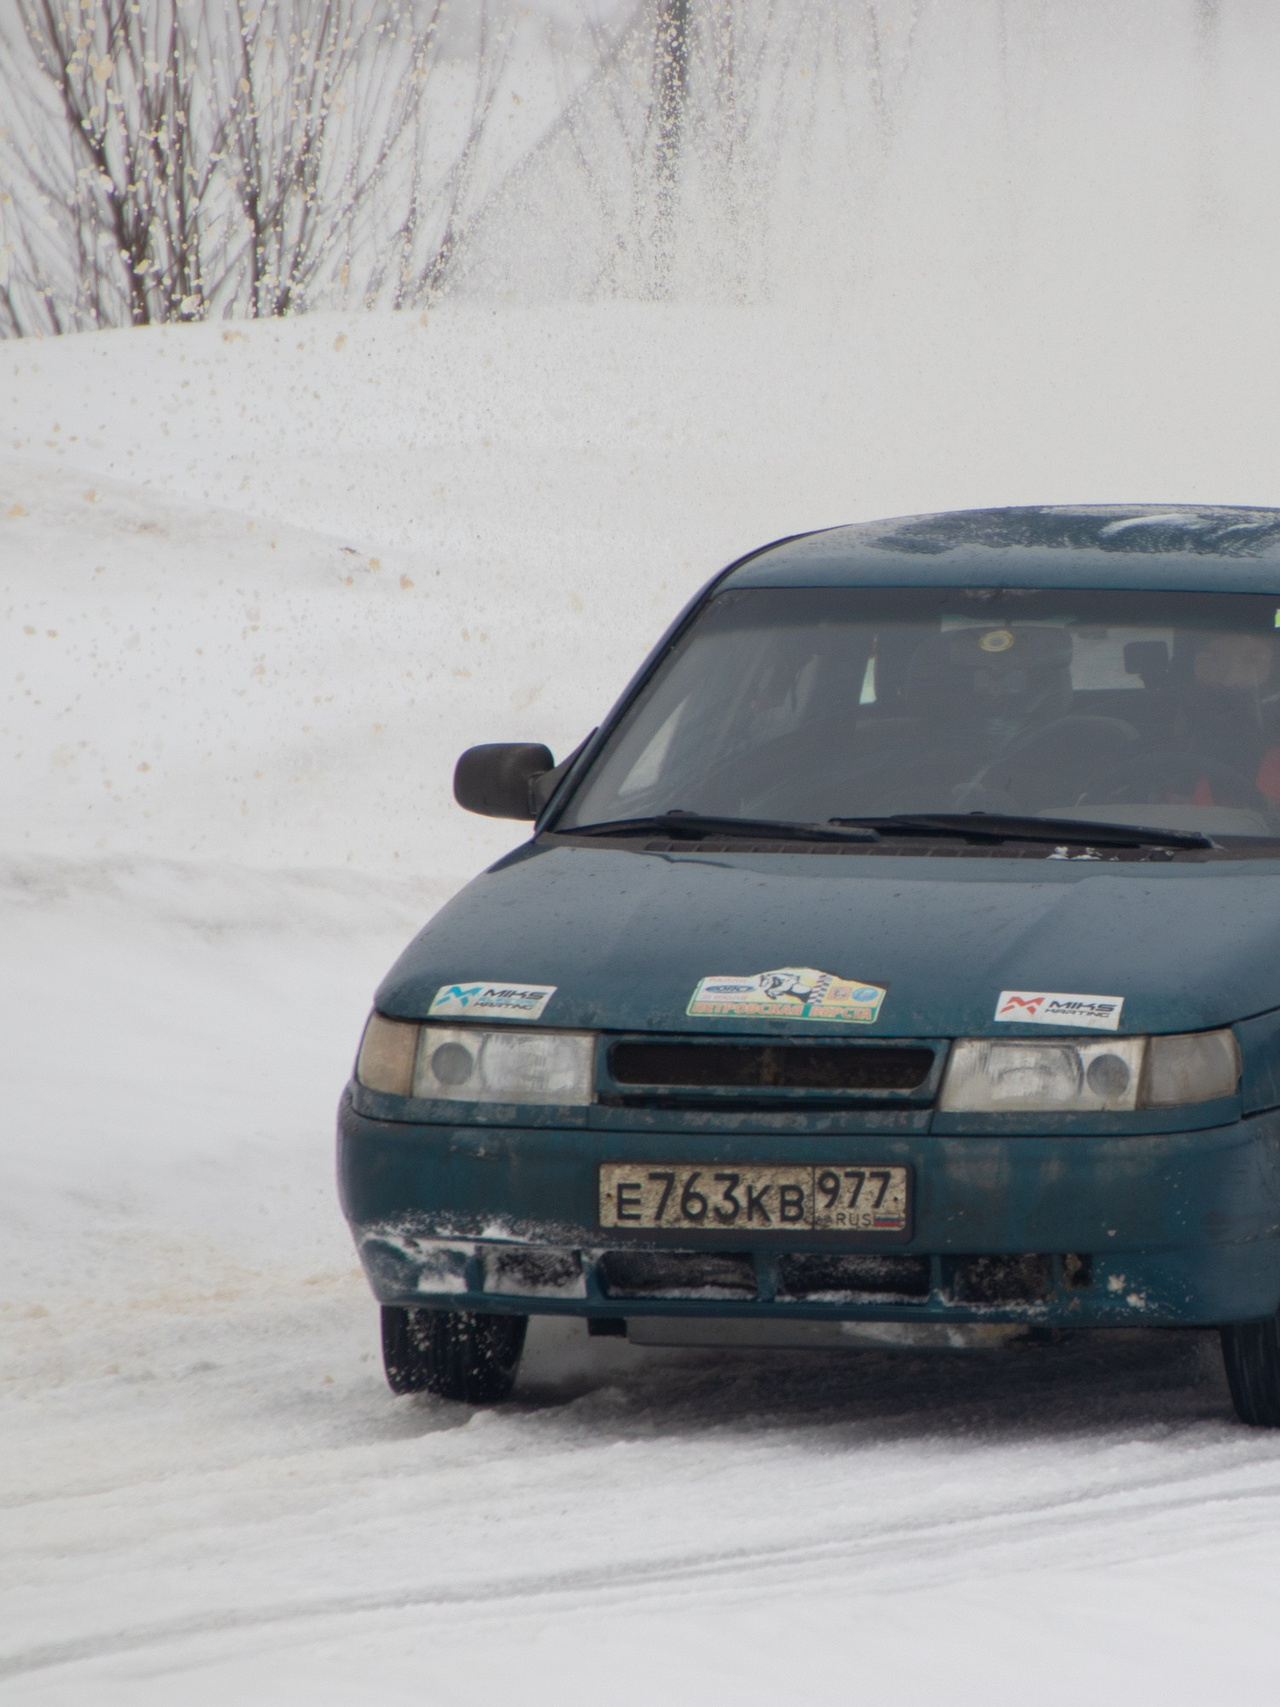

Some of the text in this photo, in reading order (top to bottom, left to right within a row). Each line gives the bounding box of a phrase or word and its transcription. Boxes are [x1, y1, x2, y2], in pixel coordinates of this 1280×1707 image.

[483, 989, 548, 1000] MIKS
[692, 1001, 872, 1020] ПЕТРОВСКАЯ ВЕРСТА
[1049, 1001, 1118, 1012] MIKS
[1045, 1009, 1109, 1018] KARTING
[616, 1171, 891, 1222] Е763КВ 977
[836, 1213, 872, 1227] RUS
